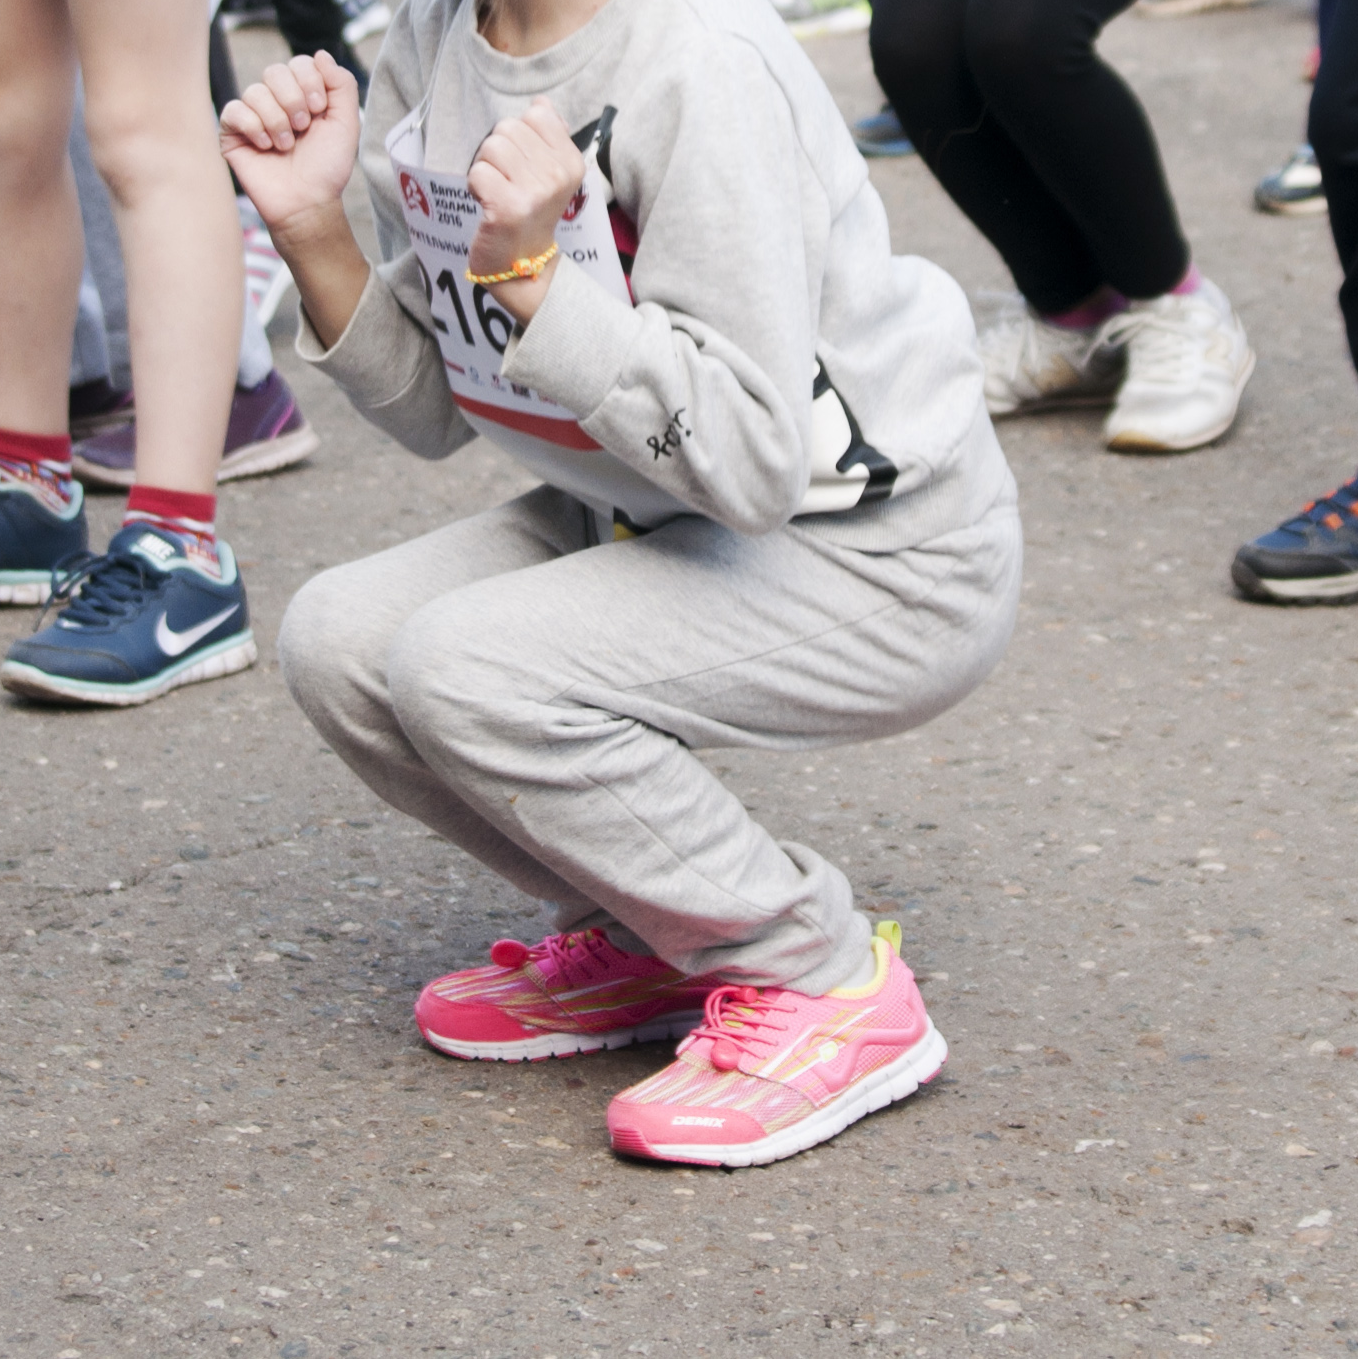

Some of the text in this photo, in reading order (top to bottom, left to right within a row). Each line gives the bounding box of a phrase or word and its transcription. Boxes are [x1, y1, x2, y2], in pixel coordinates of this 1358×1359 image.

[434, 200, 478, 214] холмы
[437, 211, 463, 228] 2016
[137, 532, 176, 561] NIKE
[671, 1115, 727, 1129] DEMIX
